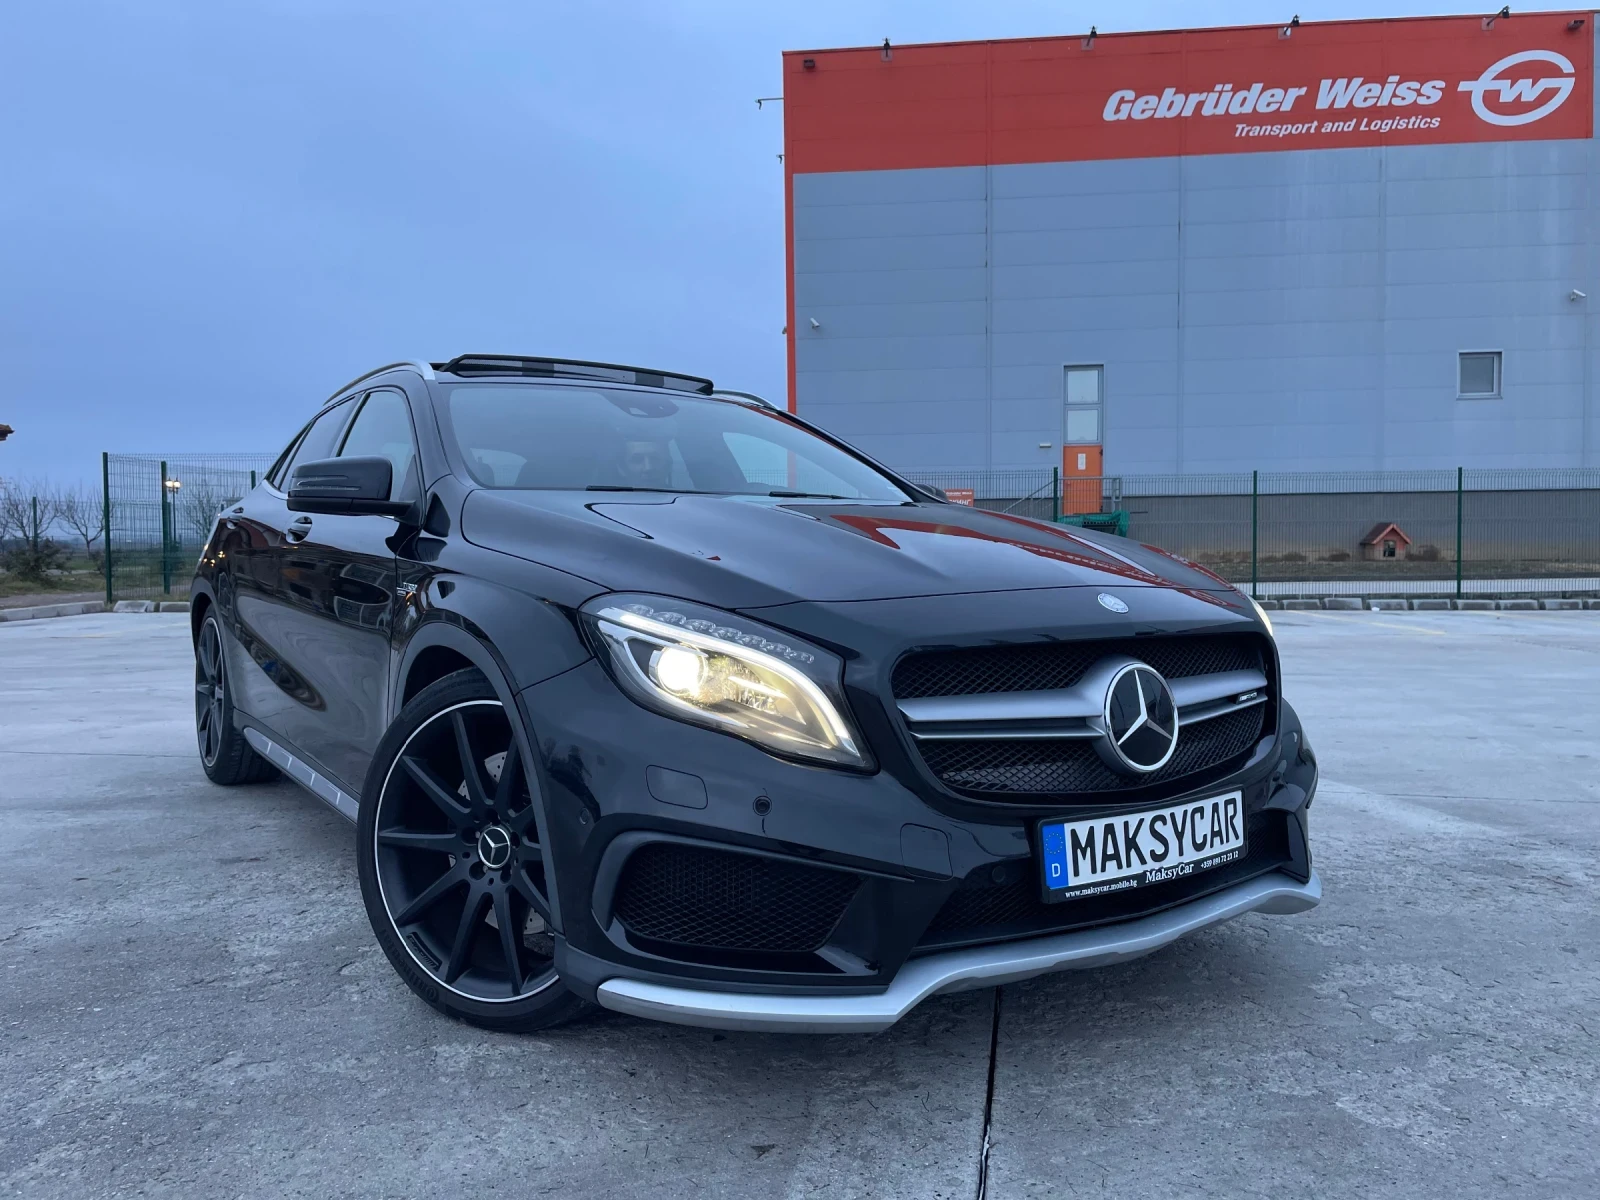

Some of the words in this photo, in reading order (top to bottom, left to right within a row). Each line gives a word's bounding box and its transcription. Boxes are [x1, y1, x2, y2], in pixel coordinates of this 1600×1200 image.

[1103, 82, 1307, 121] Gebrüder
[1315, 75, 1446, 110] Weiss
[1234, 120, 1318, 138] Transport
[1322, 118, 1354, 133] and
[1359, 114, 1441, 132] Logistics
[1070, 797, 1240, 877] MAKSYCAR
[1051, 863, 1061, 877] D
[1145, 861, 1195, 884] MaksyCar
